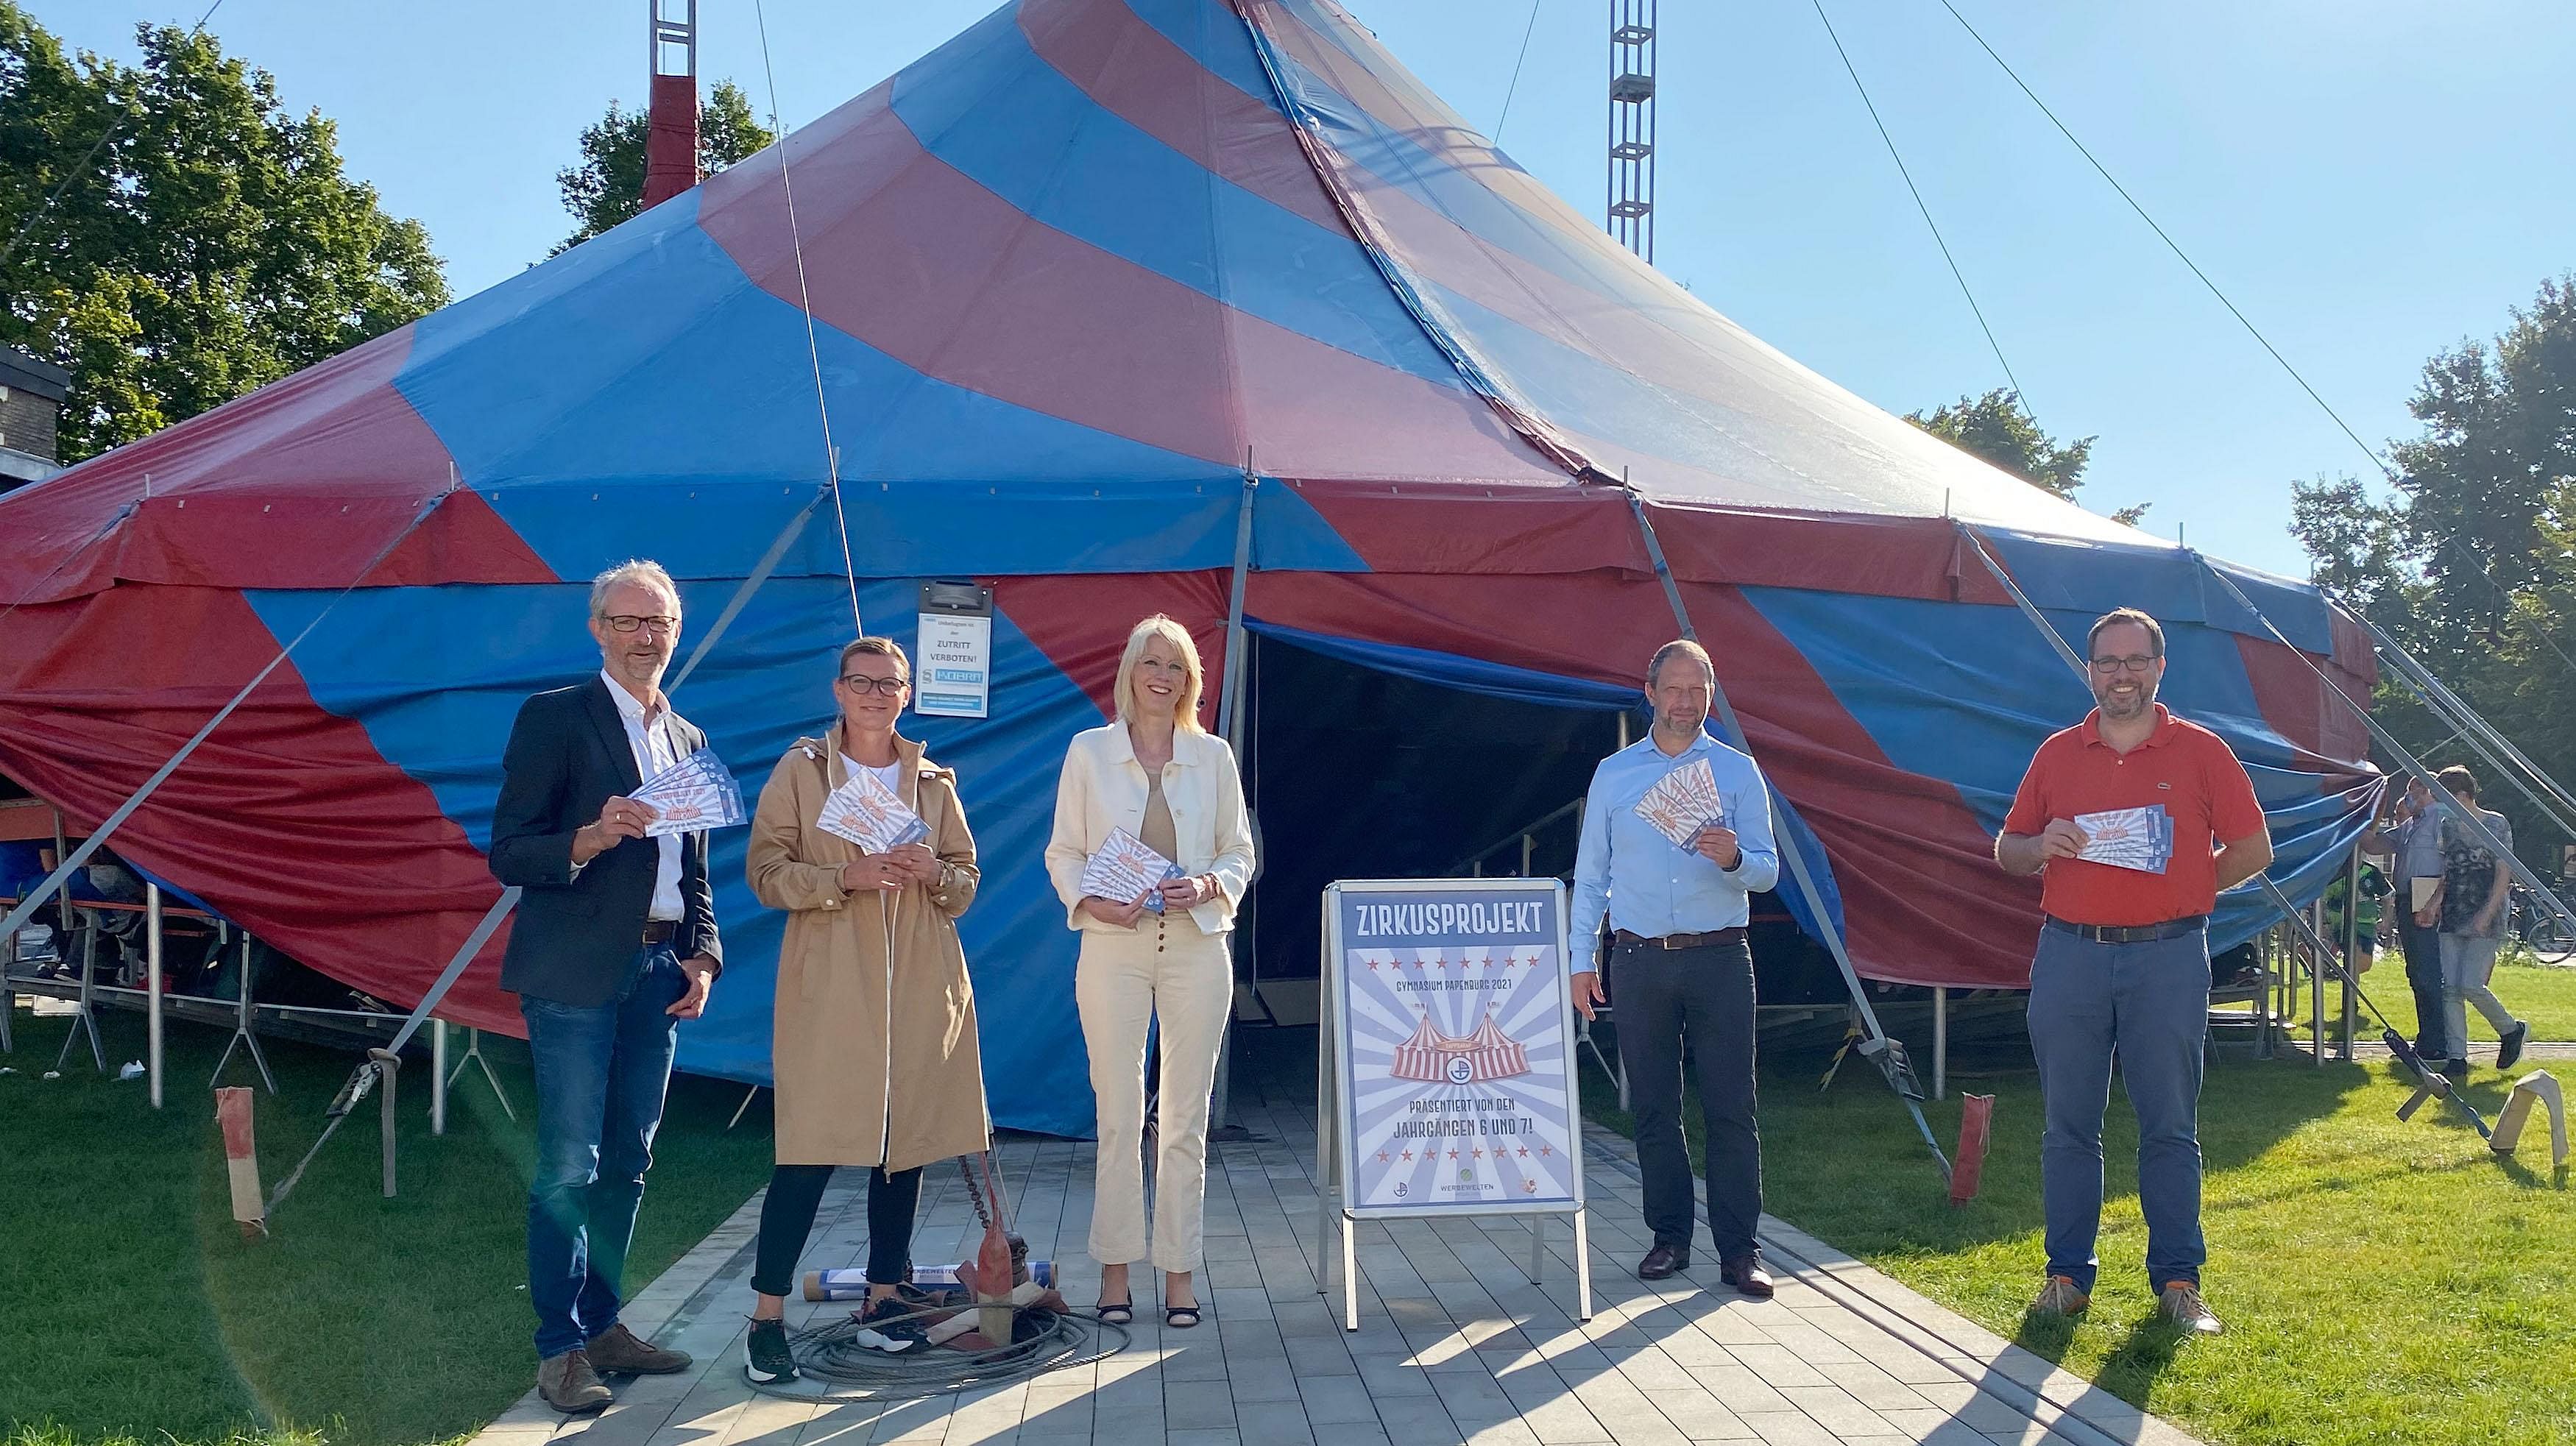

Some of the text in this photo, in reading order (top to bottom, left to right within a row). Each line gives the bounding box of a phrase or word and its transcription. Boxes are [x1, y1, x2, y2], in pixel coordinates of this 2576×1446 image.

[937, 640, 972, 649] ZUTRITT
[930, 653, 977, 663] VERBOTEN!
[1356, 901, 1543, 936] ZIRKUSPROJEKT
[1396, 978, 1512, 992] GYMNASIUM PAPENBURG 2021
[1409, 1097, 1515, 1113] PRÄSENTIERT VON DEN
[1393, 1118, 1533, 1138] JAHRGÄNGEN 6 UND 7!
[1440, 1183, 1494, 1191] WERBEWELTEN
